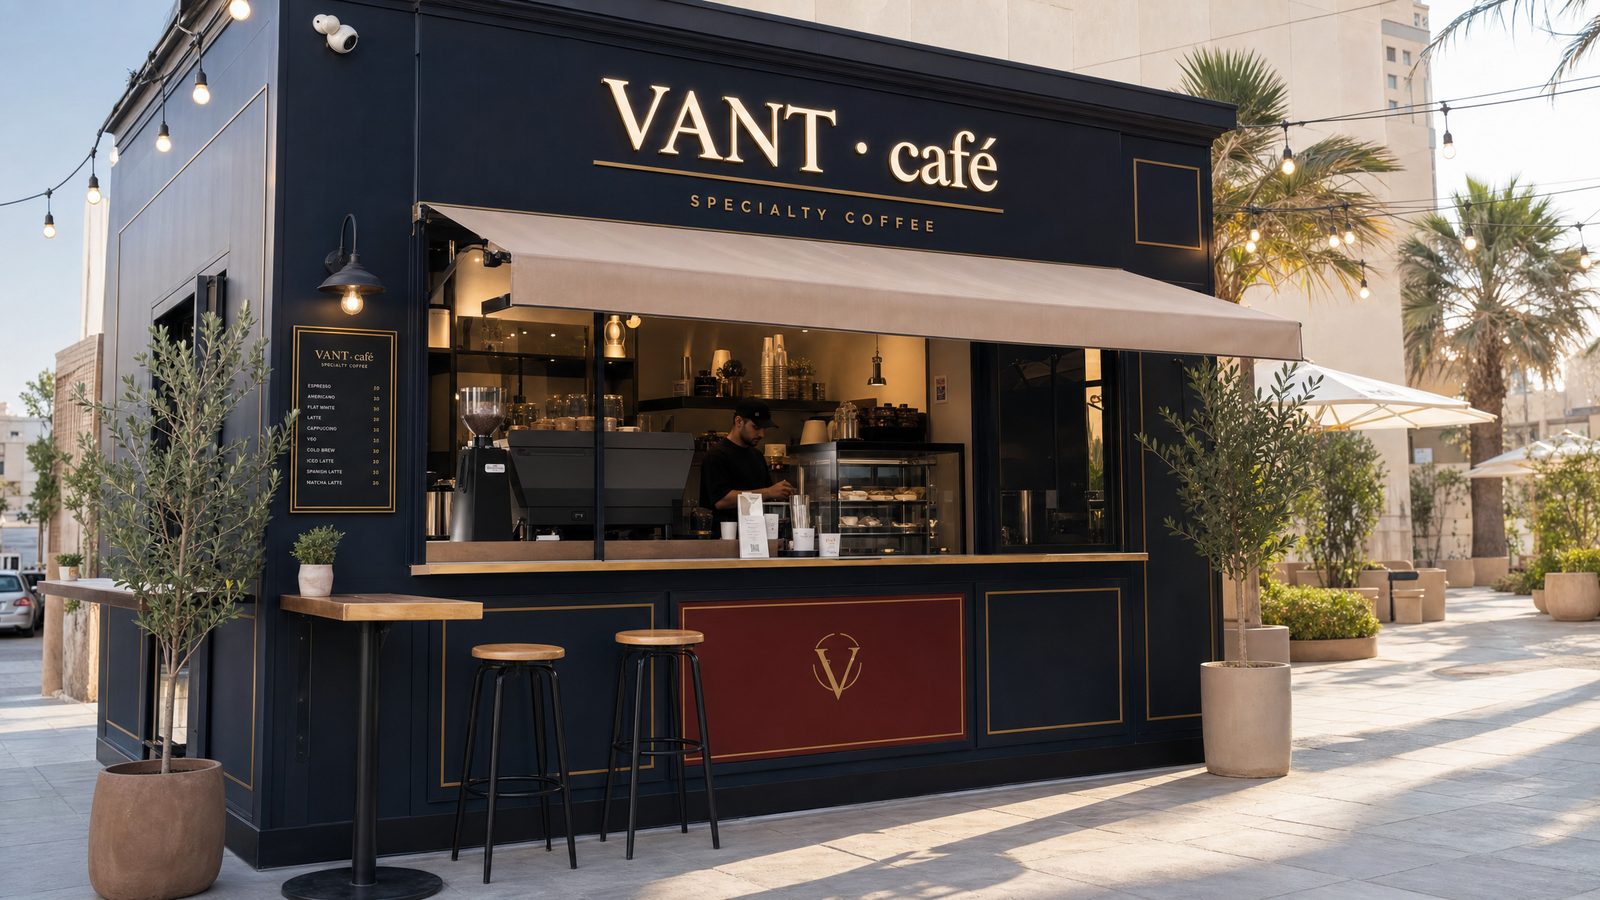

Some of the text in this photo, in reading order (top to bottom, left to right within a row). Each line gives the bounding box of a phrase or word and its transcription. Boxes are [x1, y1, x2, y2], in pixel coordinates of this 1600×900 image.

[600, 77, 837, 173] VANT
[889, 131, 998, 192] café
[690, 194, 936, 233] SPECIALTY COFFEE
[315, 350, 349, 360] VANT
[354, 352, 373, 361] café
